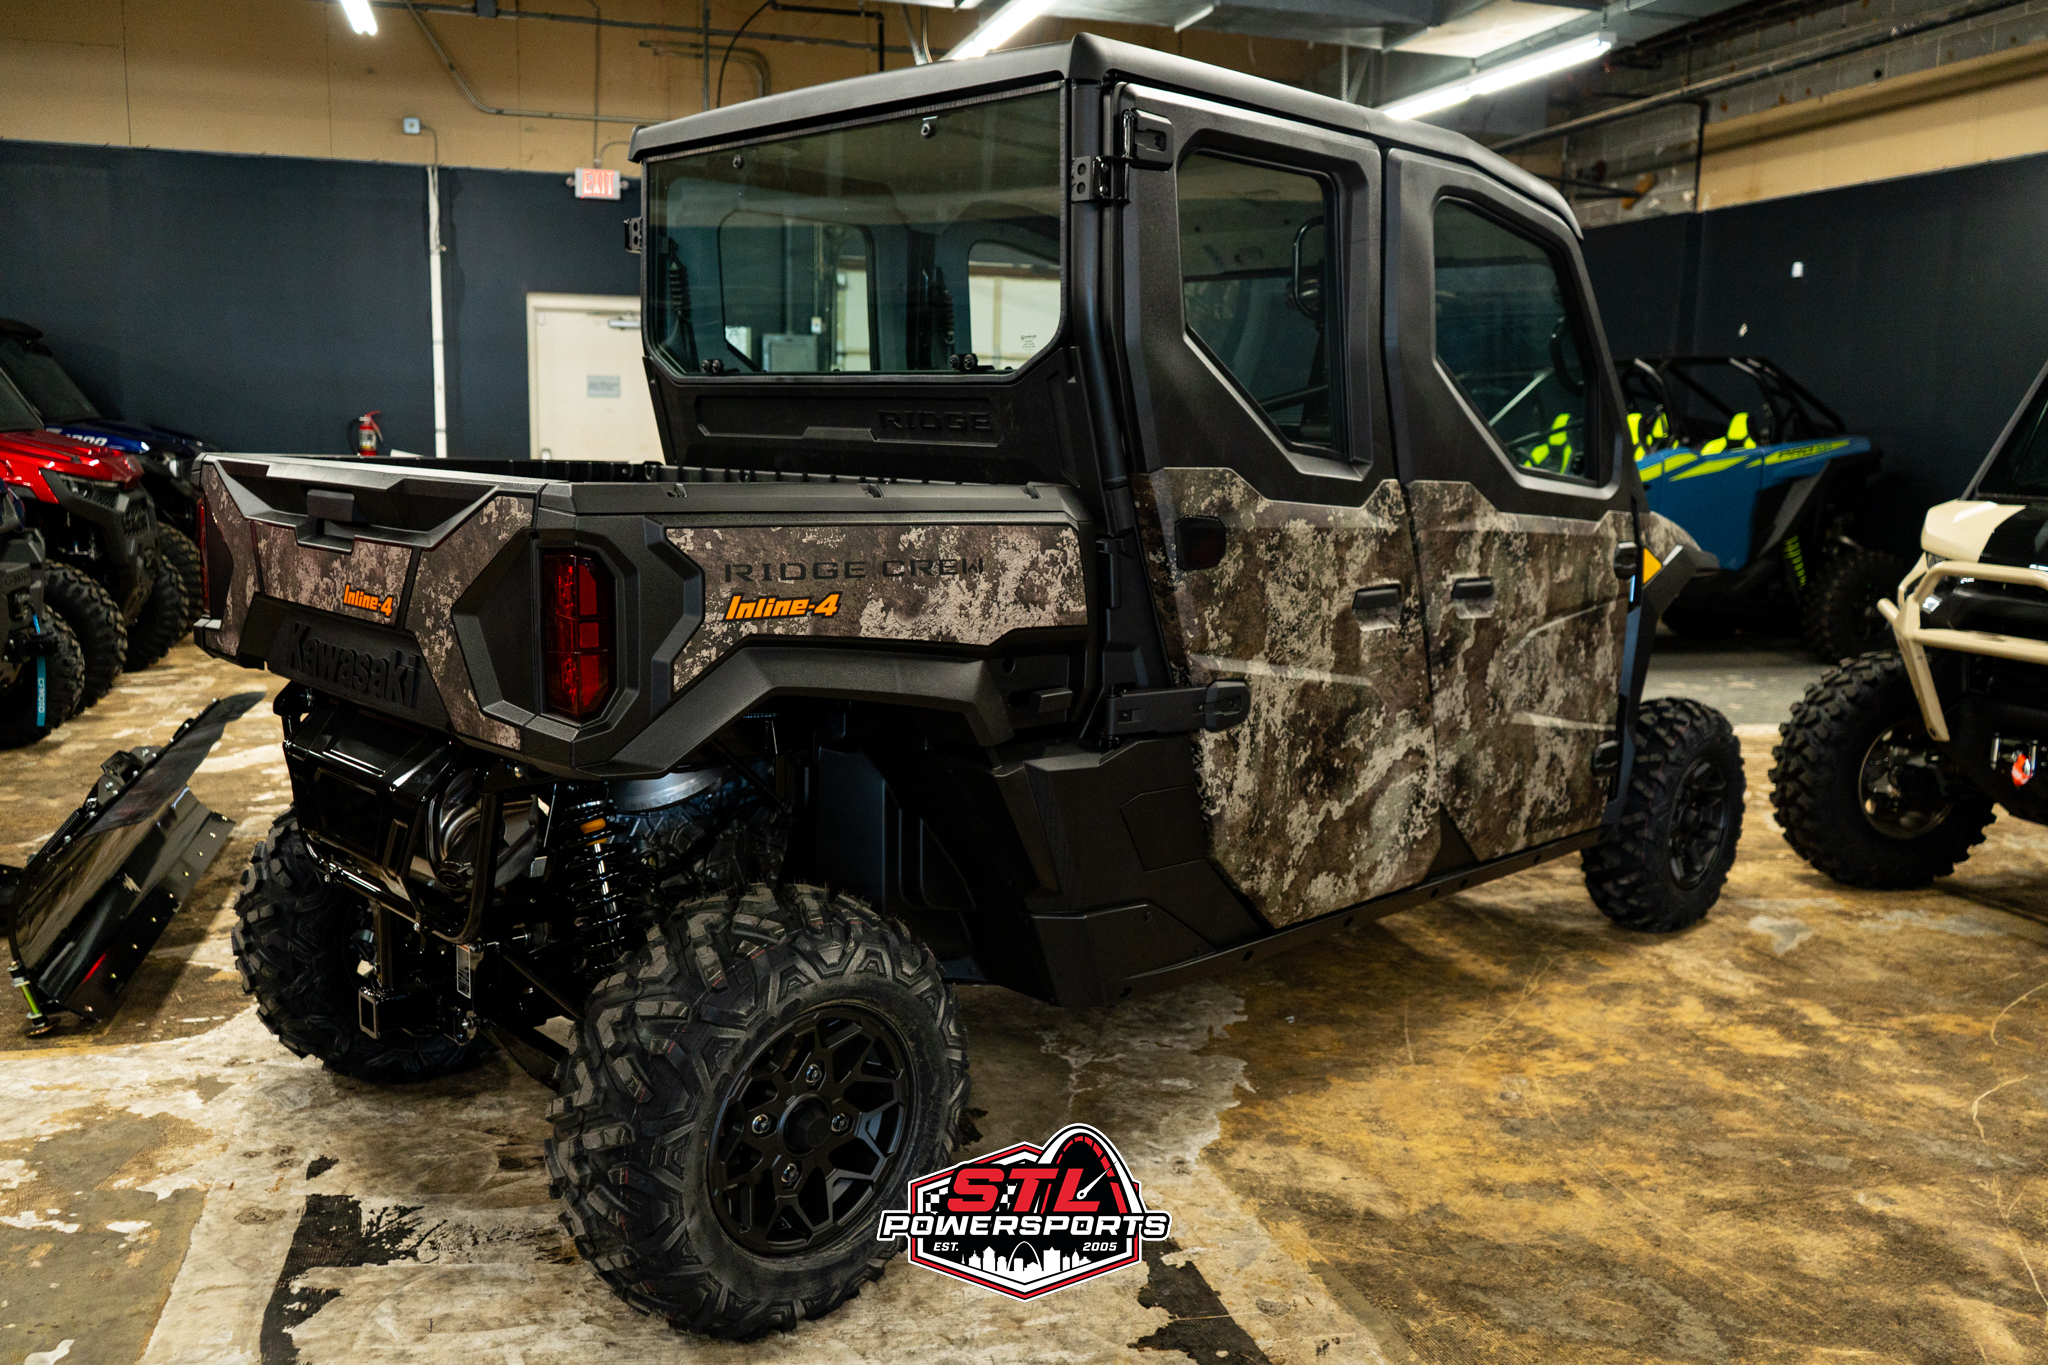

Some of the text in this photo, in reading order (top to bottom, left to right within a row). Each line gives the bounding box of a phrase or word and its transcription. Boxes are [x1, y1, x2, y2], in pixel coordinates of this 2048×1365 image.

[582, 168, 615, 197] EXIT
[879, 410, 991, 430] RIDGE
[725, 557, 984, 582] RIDGE CREW
[343, 583, 394, 617] Inline-4
[725, 593, 841, 621] Inline-4
[291, 622, 420, 708] Kawasaki
